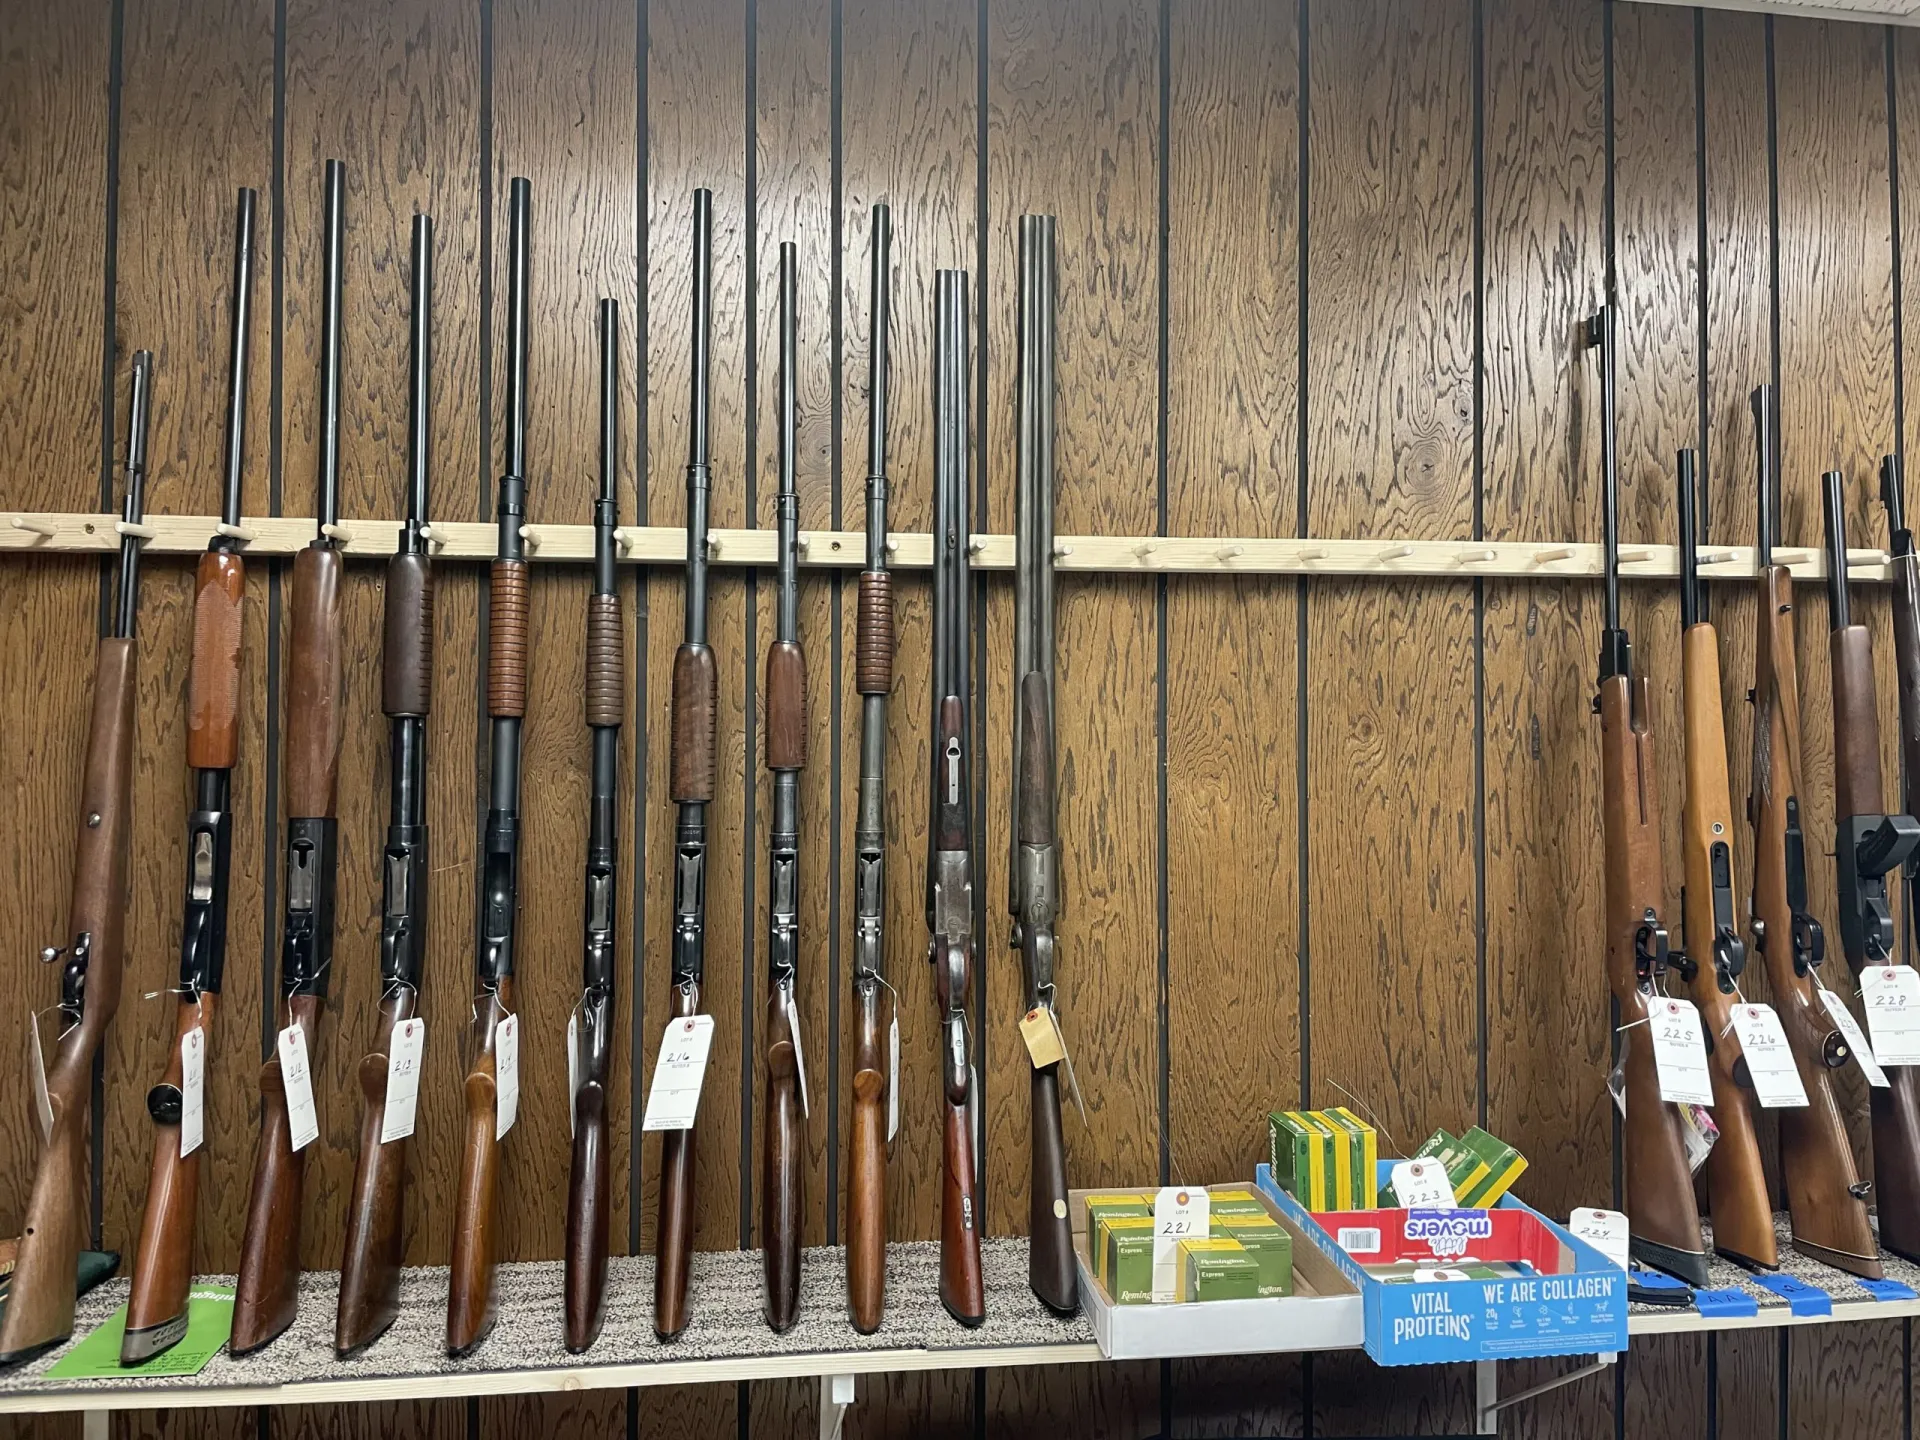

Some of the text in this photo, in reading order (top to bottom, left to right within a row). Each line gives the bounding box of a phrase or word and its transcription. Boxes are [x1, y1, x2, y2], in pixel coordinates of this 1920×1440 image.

[1875, 995, 1907, 1006] 228
[1663, 1027, 1694, 1041] 225
[1748, 1033, 1775, 1045] 226
[667, 1052, 690, 1062] 216
[1409, 1190, 1440, 1205] 223
[1163, 1222, 1191, 1234] 221
[1407, 1221, 1488, 1237] movers
[1580, 1227, 1610, 1237] 224
[1431, 1237, 1465, 1253] little
[1121, 1290, 1152, 1302] Reming
[1483, 1283, 1504, 1304] WE
[1511, 1281, 1536, 1303] ARE
[1411, 1292, 1452, 1315] VITAL
[1394, 1314, 1471, 1345] PROTEINS
